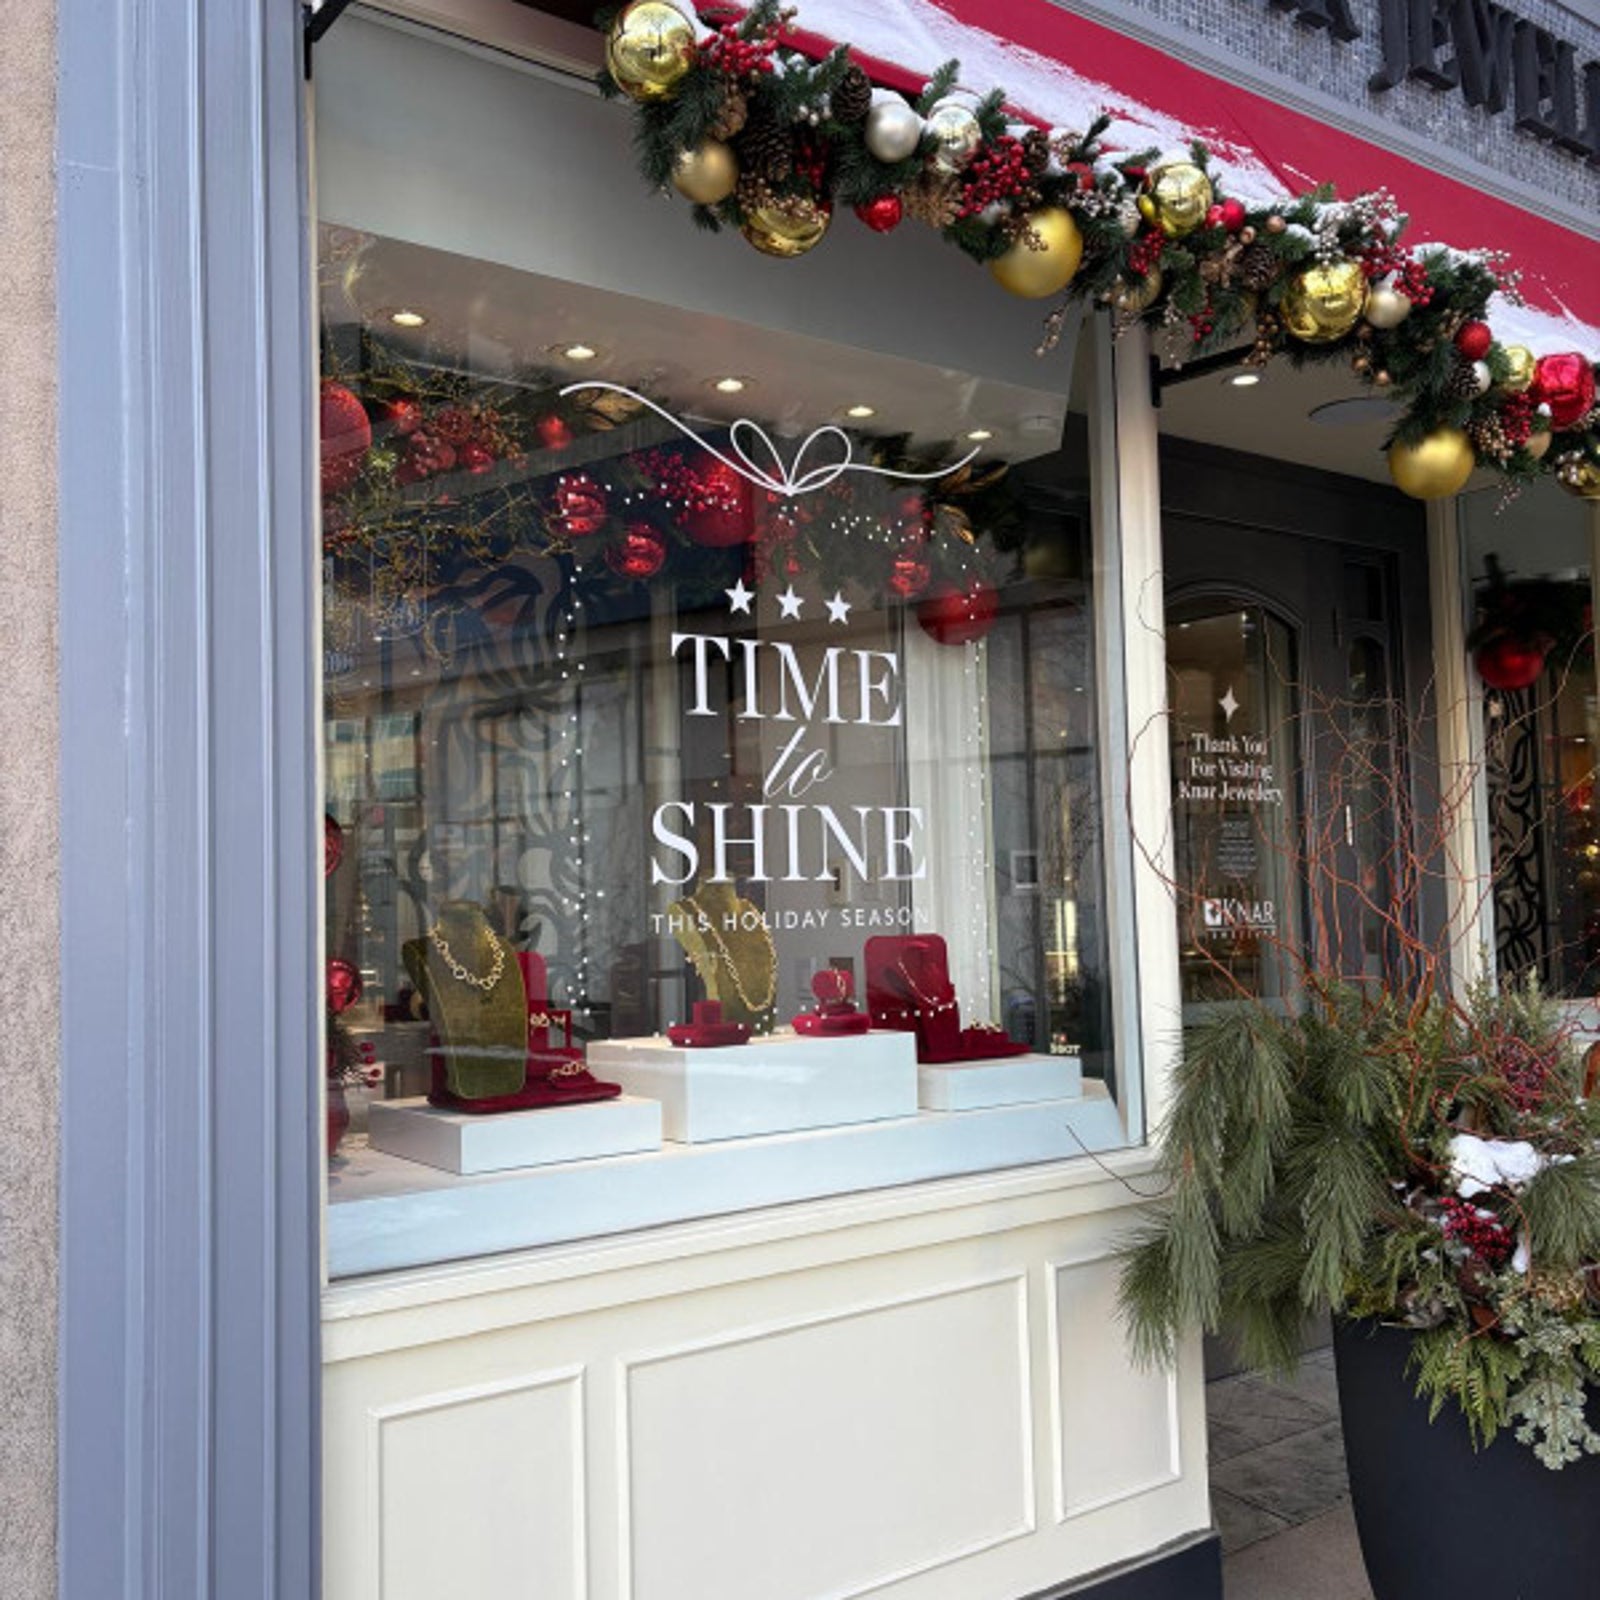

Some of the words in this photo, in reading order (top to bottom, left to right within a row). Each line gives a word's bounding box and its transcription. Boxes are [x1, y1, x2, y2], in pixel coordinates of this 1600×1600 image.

[1367, 0, 1600, 172] JEWEL
[671, 632, 902, 727] TIME
[763, 725, 834, 798] to
[1190, 757, 1216, 777] For
[1191, 732, 1240, 753] Thank
[1178, 781, 1216, 800] Knar
[651, 801, 927, 885] SHINE
[651, 912, 712, 934] THIS
[722, 908, 831, 932] HOLIDAY
[840, 905, 930, 928] SEASON
